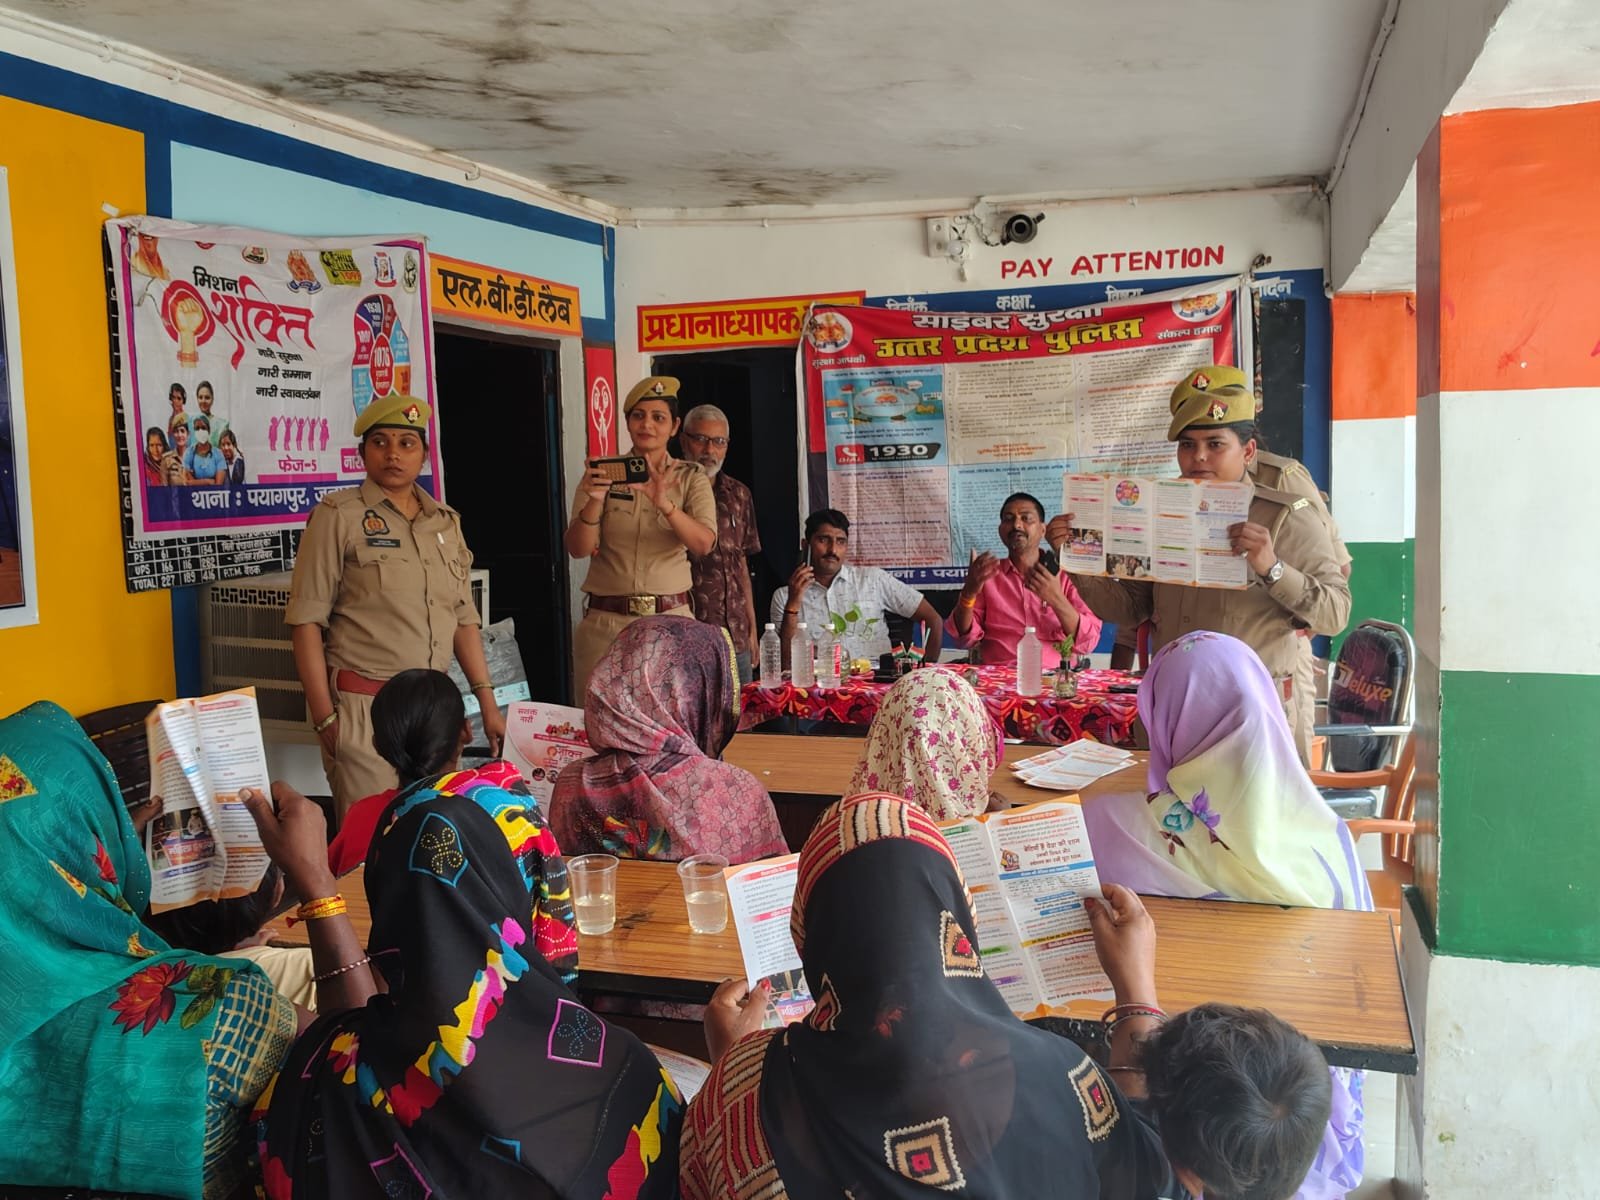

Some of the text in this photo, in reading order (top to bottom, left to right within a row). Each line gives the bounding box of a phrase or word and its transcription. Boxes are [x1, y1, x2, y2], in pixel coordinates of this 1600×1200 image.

[1001, 245, 1225, 280] PAY ATTENTION
[192, 265, 239, 294] मिशन
[210, 274, 317, 372] शक्ति
[644, 308, 800, 342] प्रधानाध्यापक
[912, 314, 1011, 332] साइबर
[873, 316, 1144, 359] उत्तर प्रदेश पुलिस
[257, 364, 280, 378] नारी
[255, 384, 278, 397] नारी
[869, 444, 929, 459] 1930
[191, 489, 231, 509] थाना
[133, 552, 145, 563] PS
[134, 564, 151, 575] UPS
[161, 561, 174, 573] 166
[133, 578, 157, 590] TOTAL
[161, 575, 176, 588] 227
[183, 572, 196, 583] 189
[1335, 660, 1393, 703] Deluxe
